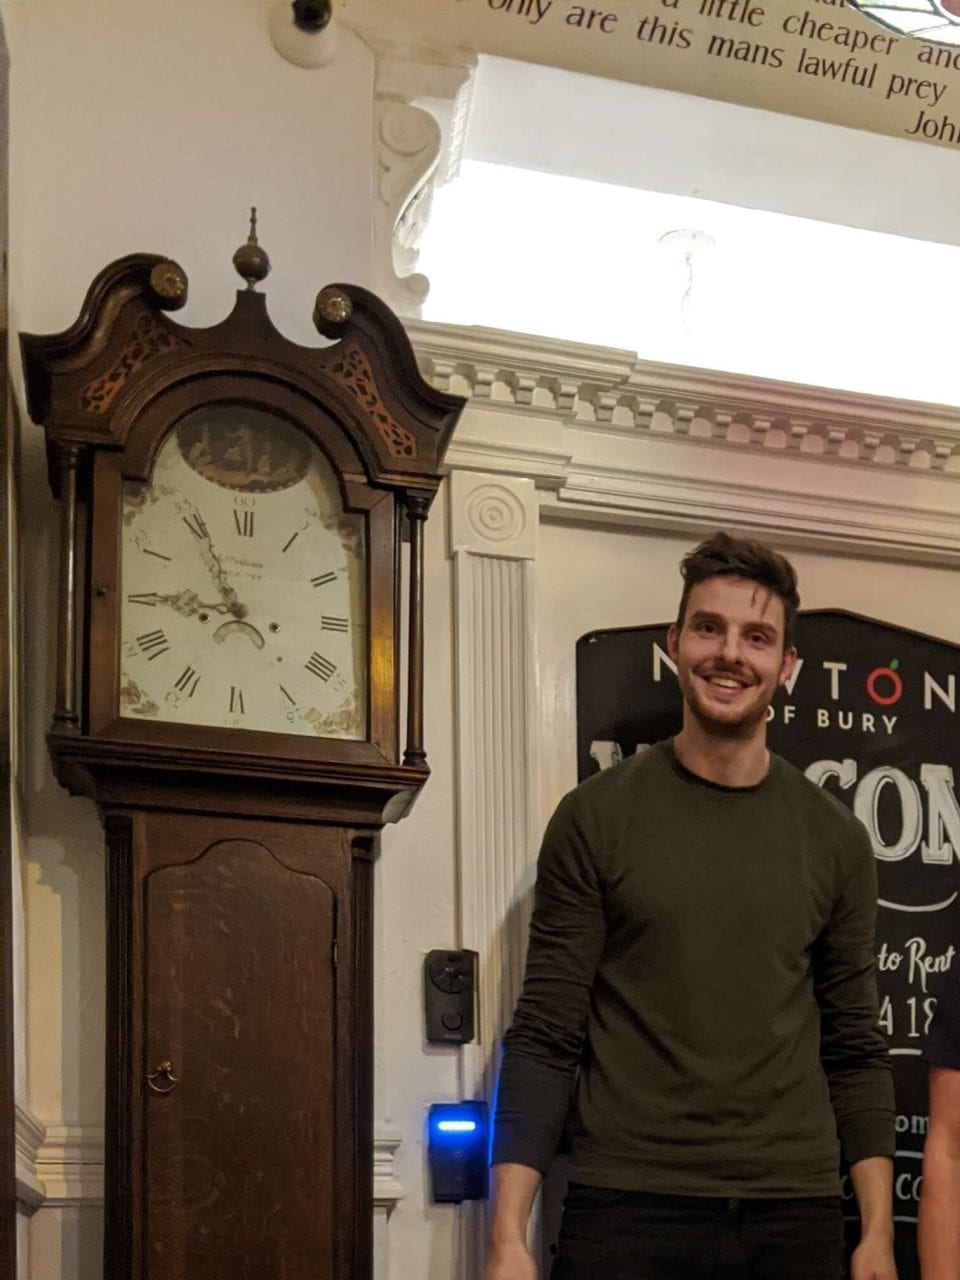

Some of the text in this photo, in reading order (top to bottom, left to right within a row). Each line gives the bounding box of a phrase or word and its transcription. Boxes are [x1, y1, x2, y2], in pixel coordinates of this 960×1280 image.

[565, 5, 618, 34] are
[636, 15, 694, 49] this
[707, 34, 785, 68] mans
[796, 48, 878, 90] lawful
[886, 71, 949, 107] prey
[782, 11, 899, 55] cheaper
[817, 708, 899, 735] BURY
[877, 937, 956, 993] to Rent
